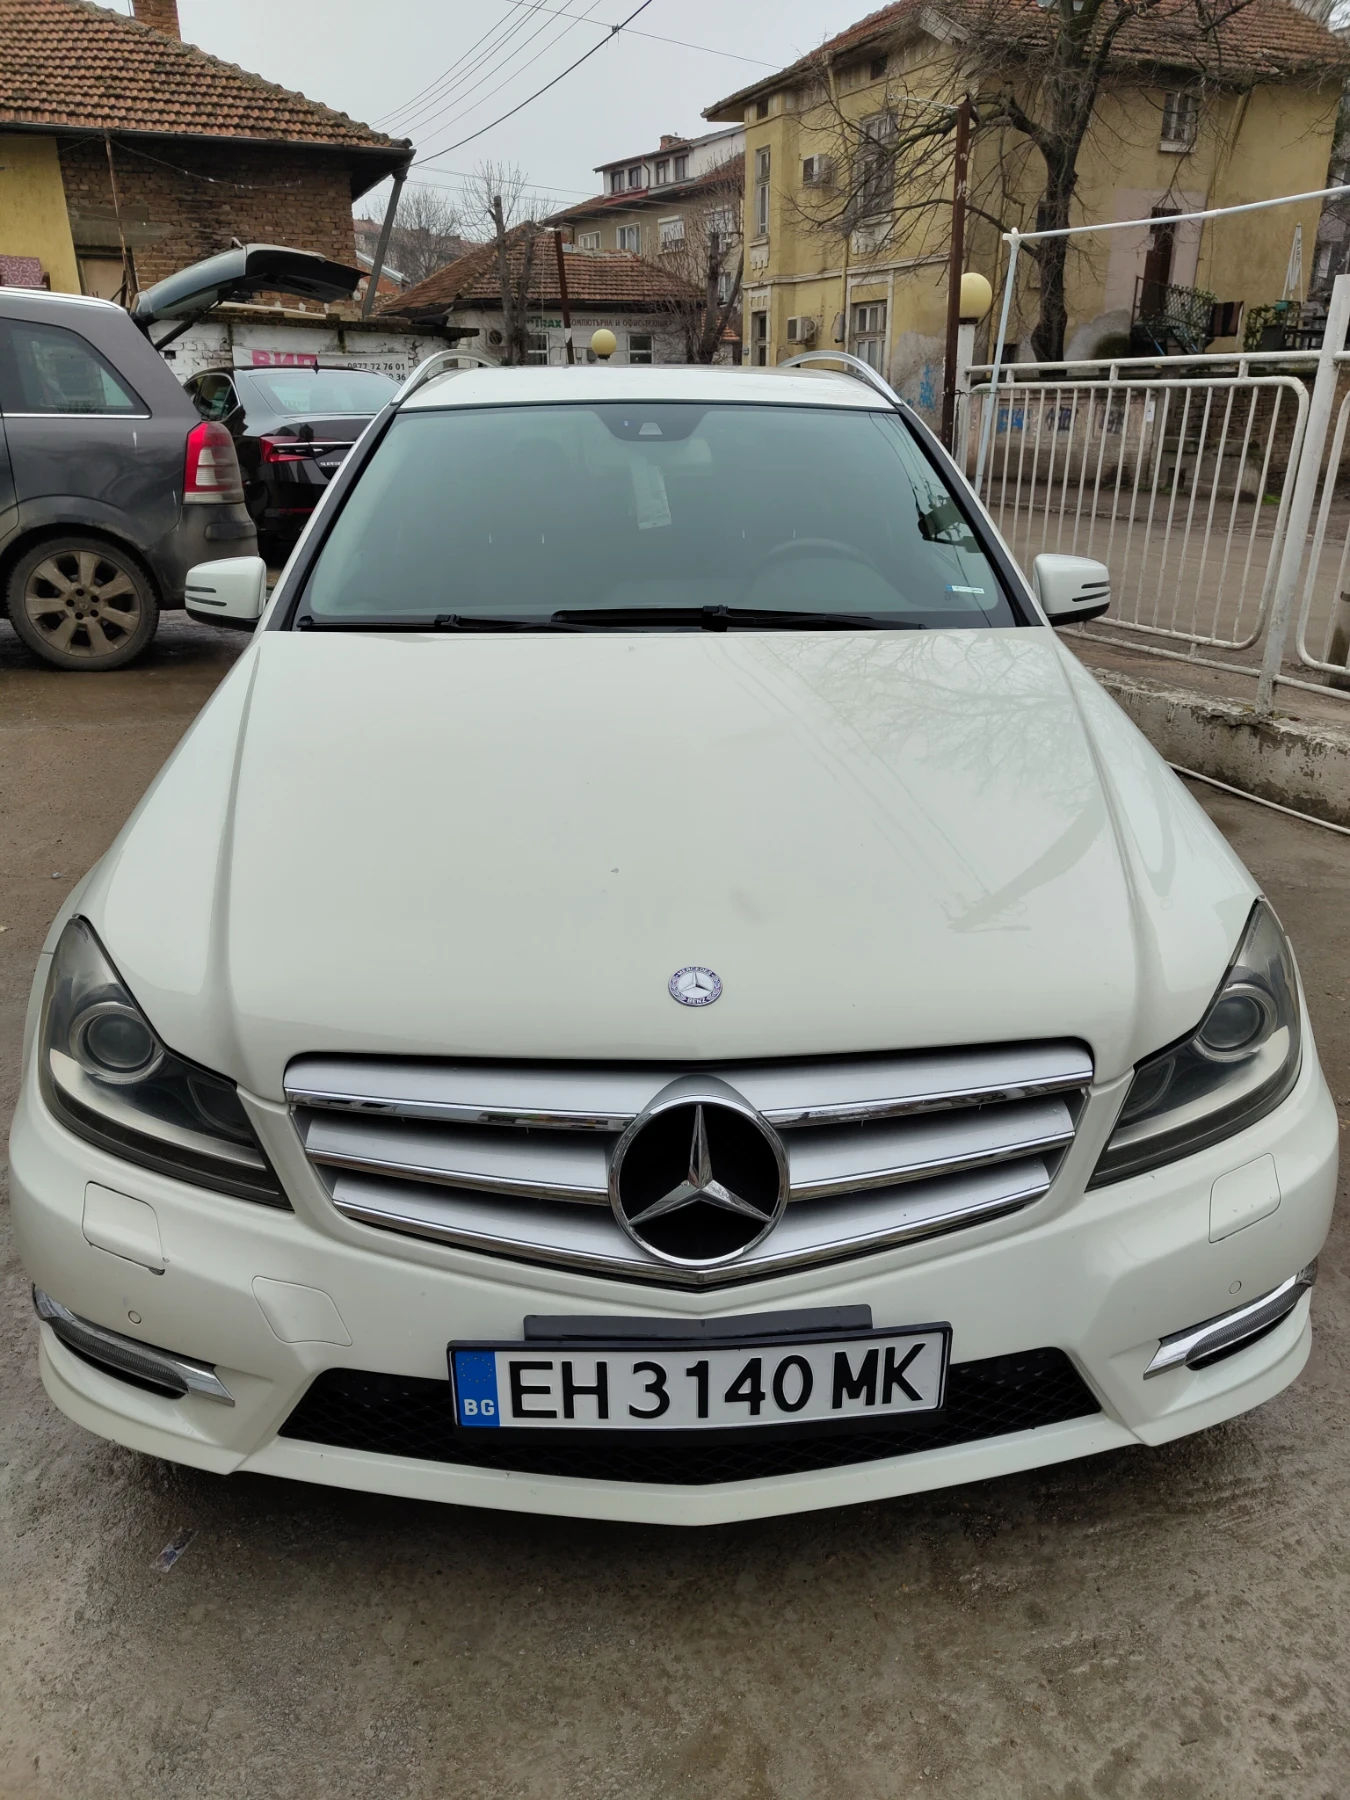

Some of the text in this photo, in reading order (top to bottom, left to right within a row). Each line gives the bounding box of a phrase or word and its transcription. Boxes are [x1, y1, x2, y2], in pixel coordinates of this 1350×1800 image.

[570, 318, 613, 327] ОМПЮТЪРНА
[370, 362, 381, 370] 72
[383, 362, 393, 371] 76
[395, 362, 405, 371] 01
[396, 373, 406, 381] 36
[508, 1342, 927, 1420] EH 3140 MK
[464, 1398, 495, 1417] BG
